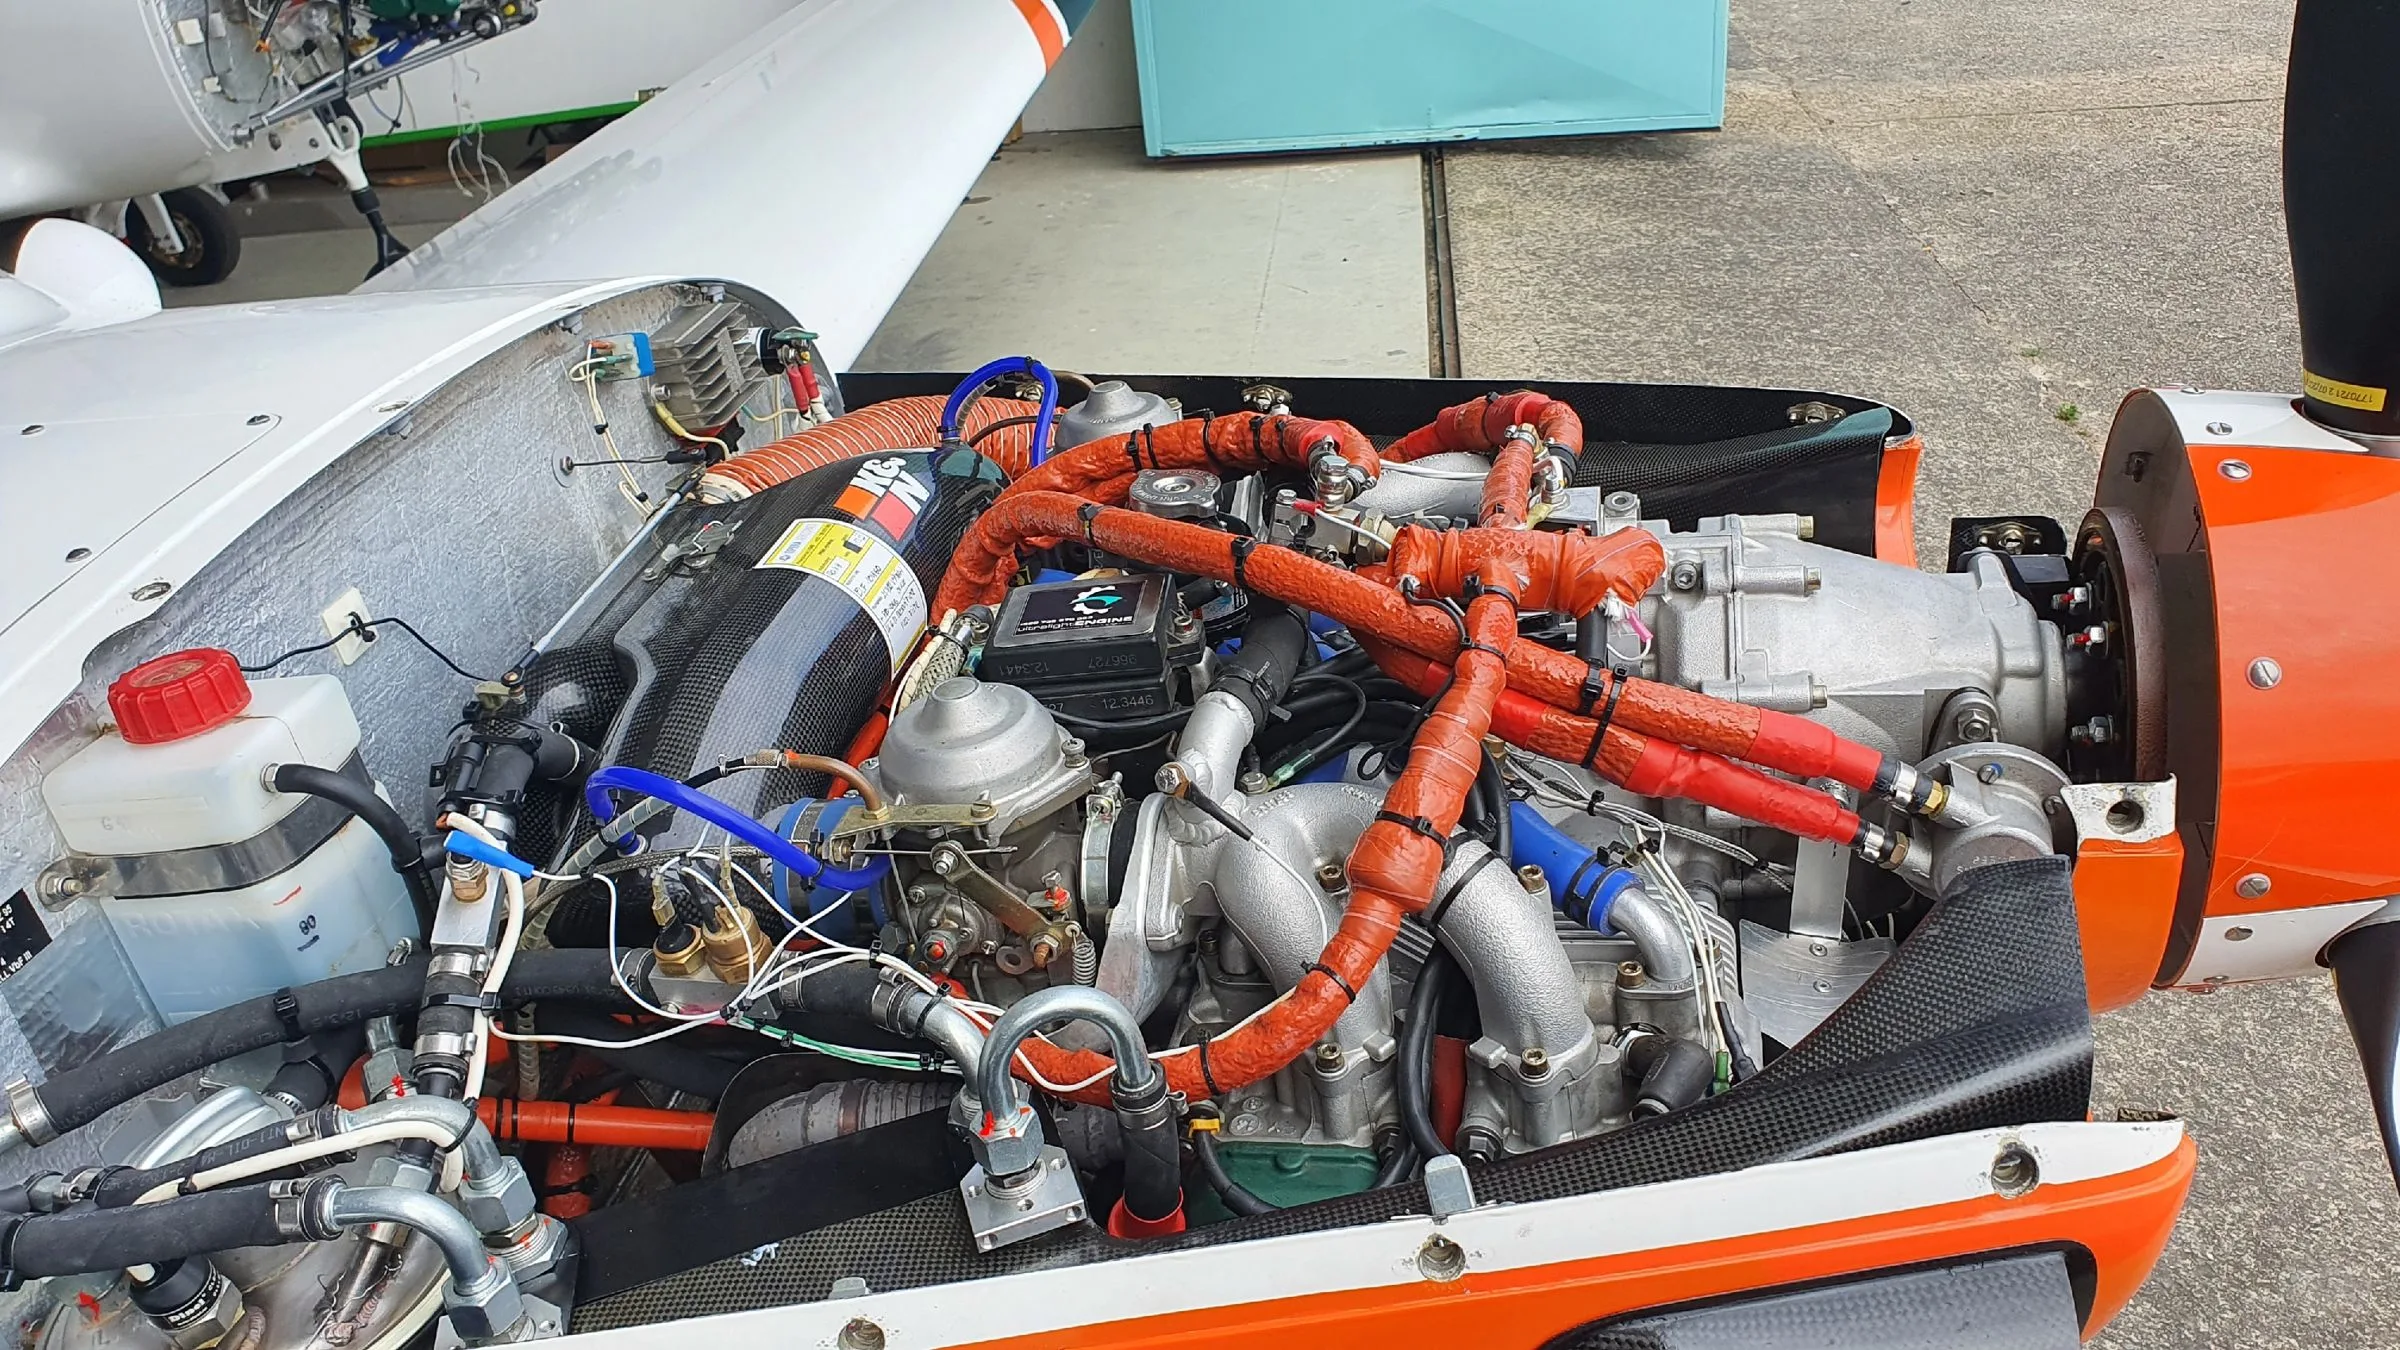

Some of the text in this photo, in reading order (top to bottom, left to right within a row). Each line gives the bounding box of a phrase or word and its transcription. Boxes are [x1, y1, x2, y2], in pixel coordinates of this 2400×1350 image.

[849, 457, 930, 516] K&N
[1102, 694, 1154, 710] 12.3446
[2, 904, 13, 917] 95
